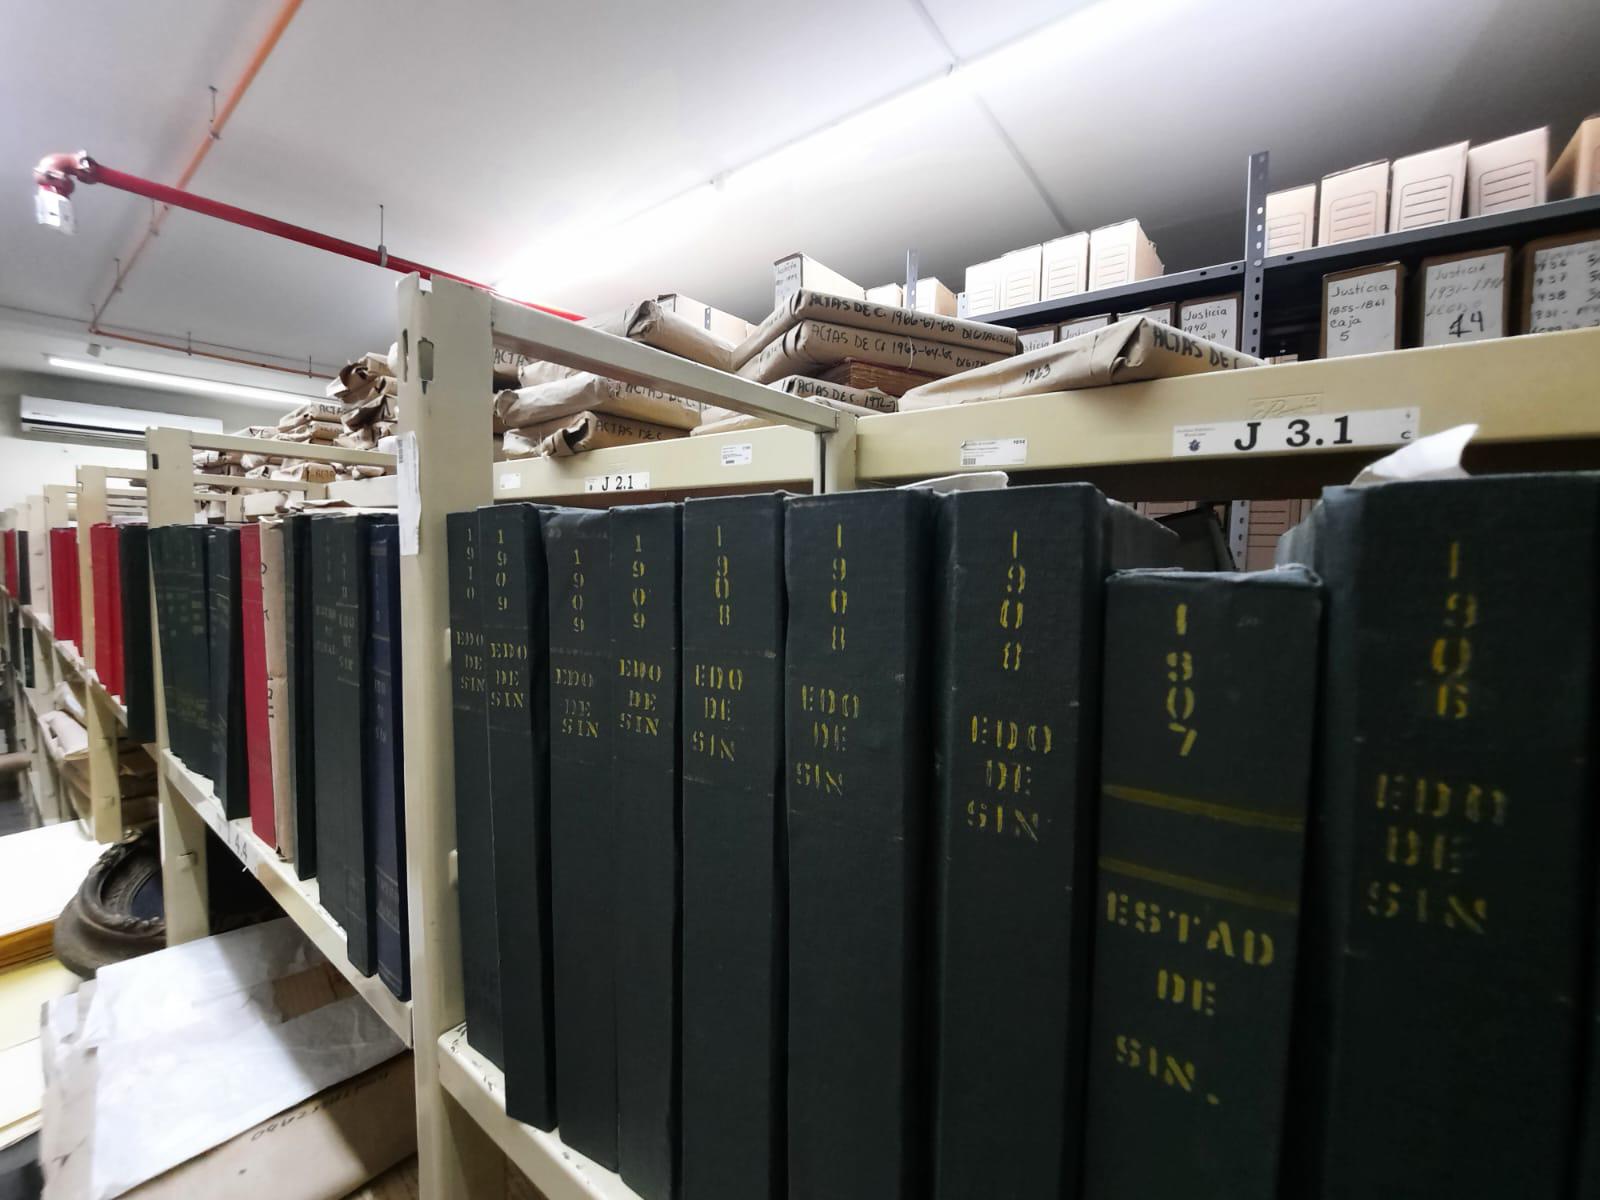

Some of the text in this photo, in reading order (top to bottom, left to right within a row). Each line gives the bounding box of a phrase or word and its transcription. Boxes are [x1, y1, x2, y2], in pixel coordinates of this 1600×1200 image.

[1331, 283, 1390, 297] Justicia
[854, 302, 871, 317] DE
[811, 323, 849, 344] ACTAS
[854, 335, 870, 351] DE
[1340, 330, 1351, 341] 5
[798, 378, 829, 397] ACTAS
[833, 389, 847, 401] DE
[1234, 415, 1353, 451] J 3.1
[601, 475, 633, 491] J 2.1
[496, 529, 508, 611] 1909
[632, 535, 646, 630] 1909
[572, 549, 585, 633] 1909
[456, 631, 484, 647] EDO
[1430, 542, 1478, 719] 1906
[465, 654, 482, 671] DE
[490, 642, 528, 660] EDO
[460, 675, 486, 692] SIN
[496, 669, 520, 687] DE
[554, 668, 594, 688] EDO
[618, 658, 662, 684] EDO
[695, 664, 743, 691] EDO
[1167, 603, 1197, 757] 1907
[491, 691, 524, 708] SIN
[564, 698, 591, 717] DE
[629, 689, 657, 711] DE
[704, 696, 731, 721] DE
[802, 684, 860, 719] EDO
[562, 718, 599, 738] SIN
[619, 713, 661, 737] SIN
[812, 721, 847, 752] DE
[971, 715, 1052, 754] EDO
[692, 730, 735, 761] SIN
[796, 762, 843, 796] SIN
[986, 759, 1031, 795] DE
[1376, 773, 1506, 826] EDO
[967, 800, 1039, 842] SIN
[1386, 825, 1462, 873] DE
[1367, 880, 1488, 935] SIN
[1107, 890, 1275, 967] ESTAD
[1157, 969, 1216, 1016] DE
